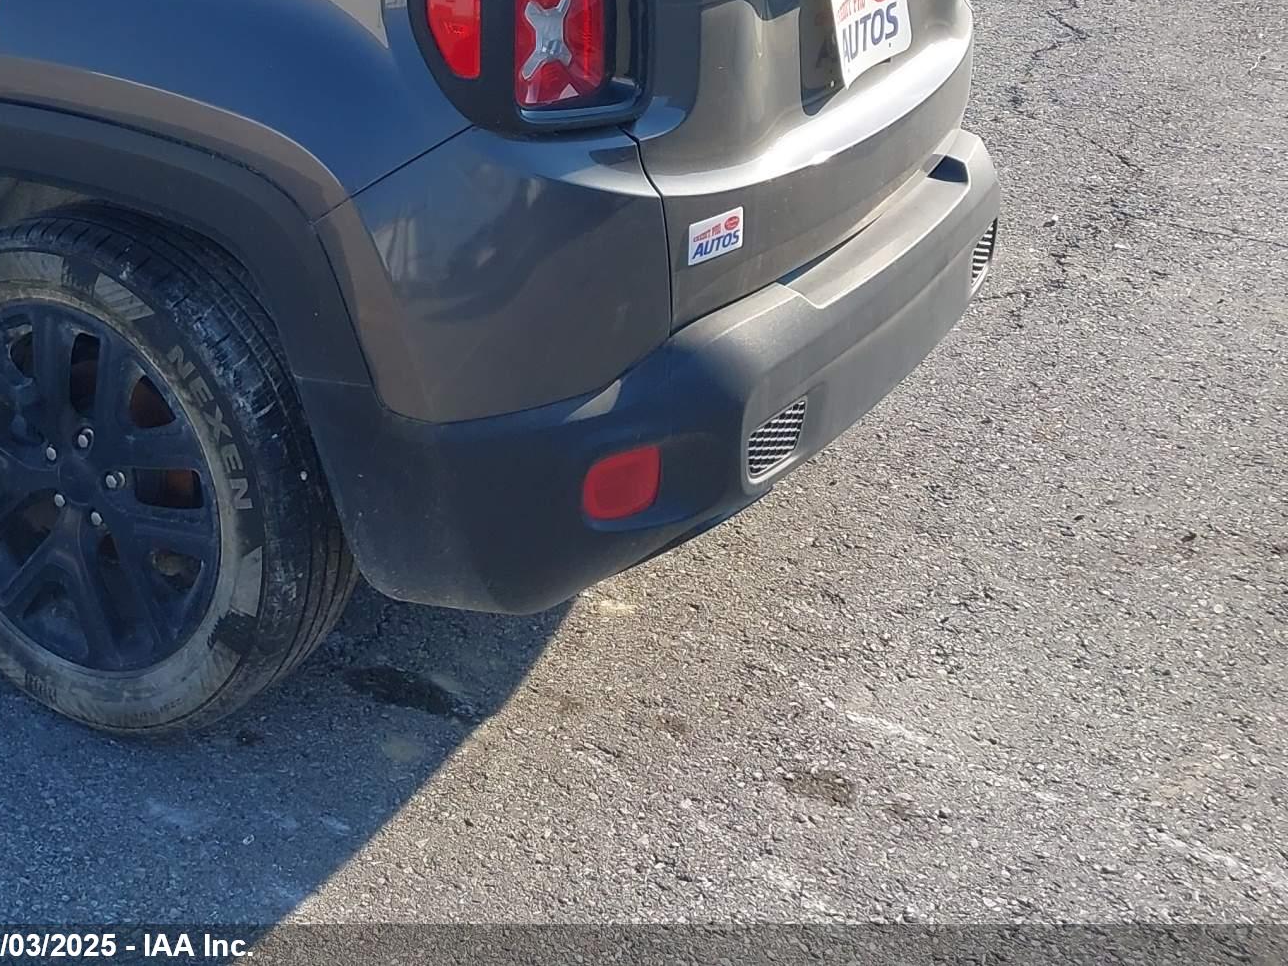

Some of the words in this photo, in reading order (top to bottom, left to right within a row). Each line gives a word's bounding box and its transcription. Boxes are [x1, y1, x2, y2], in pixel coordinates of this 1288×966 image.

[842, 1, 899, 63] AUTOS
[692, 229, 741, 260] AUTOS
[167, 345, 254, 511] NEXEN
